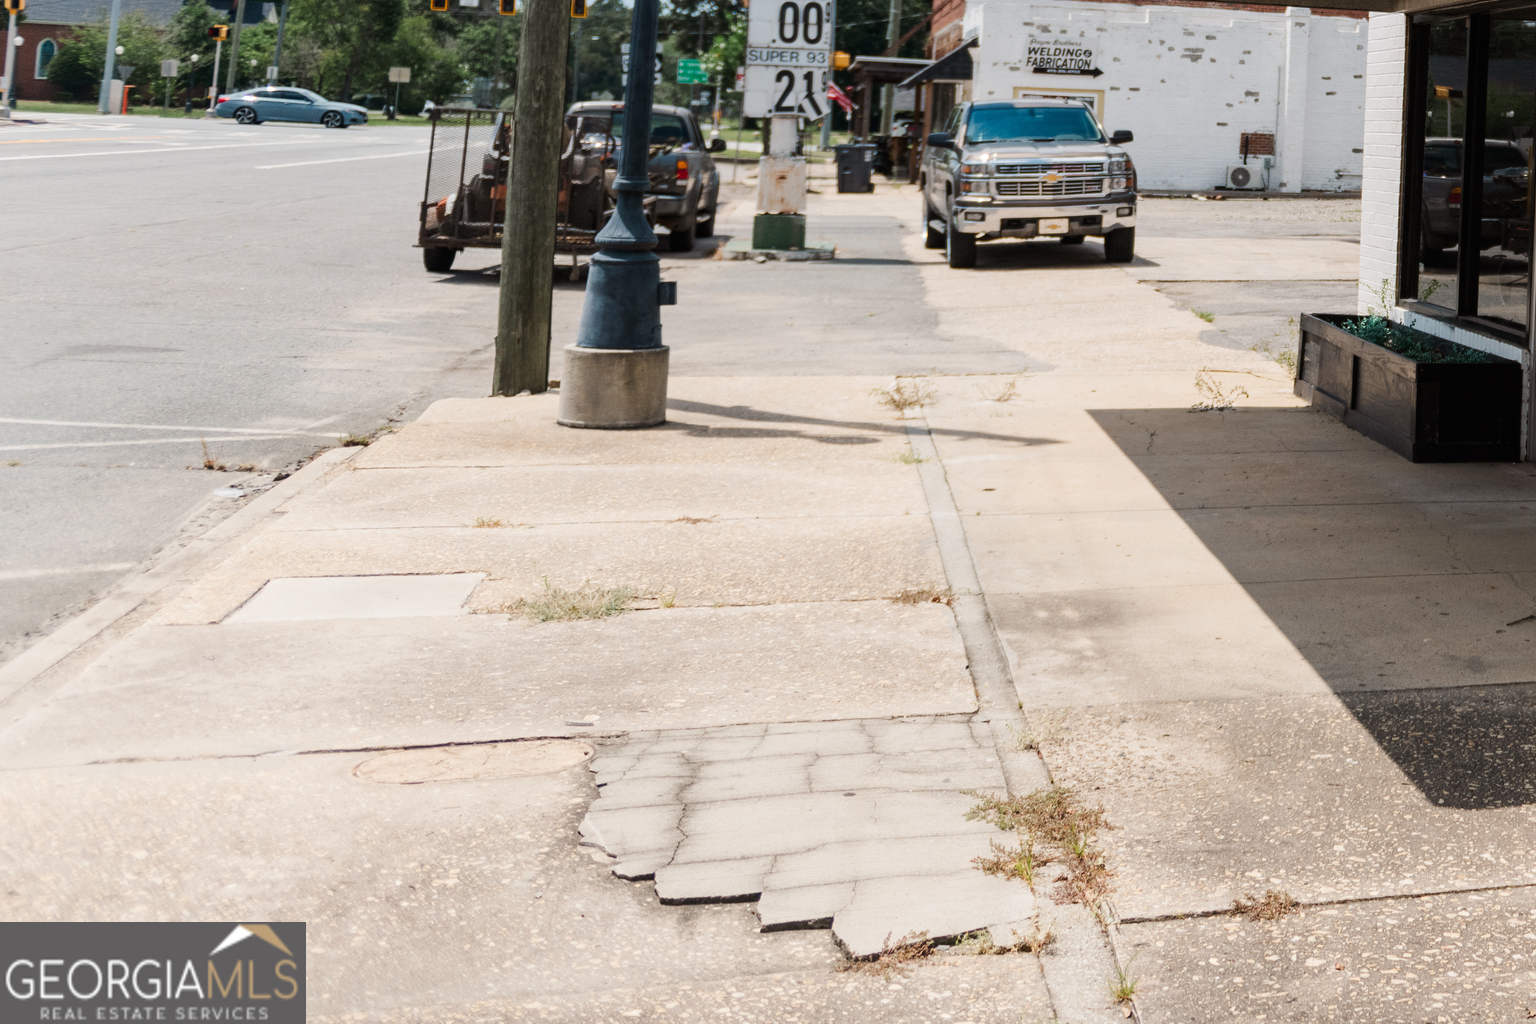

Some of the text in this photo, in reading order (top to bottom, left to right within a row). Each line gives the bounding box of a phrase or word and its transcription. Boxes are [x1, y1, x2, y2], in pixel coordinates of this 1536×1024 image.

[1052, 38, 1082, 47] Brothers
[748, 49, 826, 64] SUPER 93
[1028, 46, 1083, 57] WELDING
[1026, 56, 1092, 69] FABRICATION
